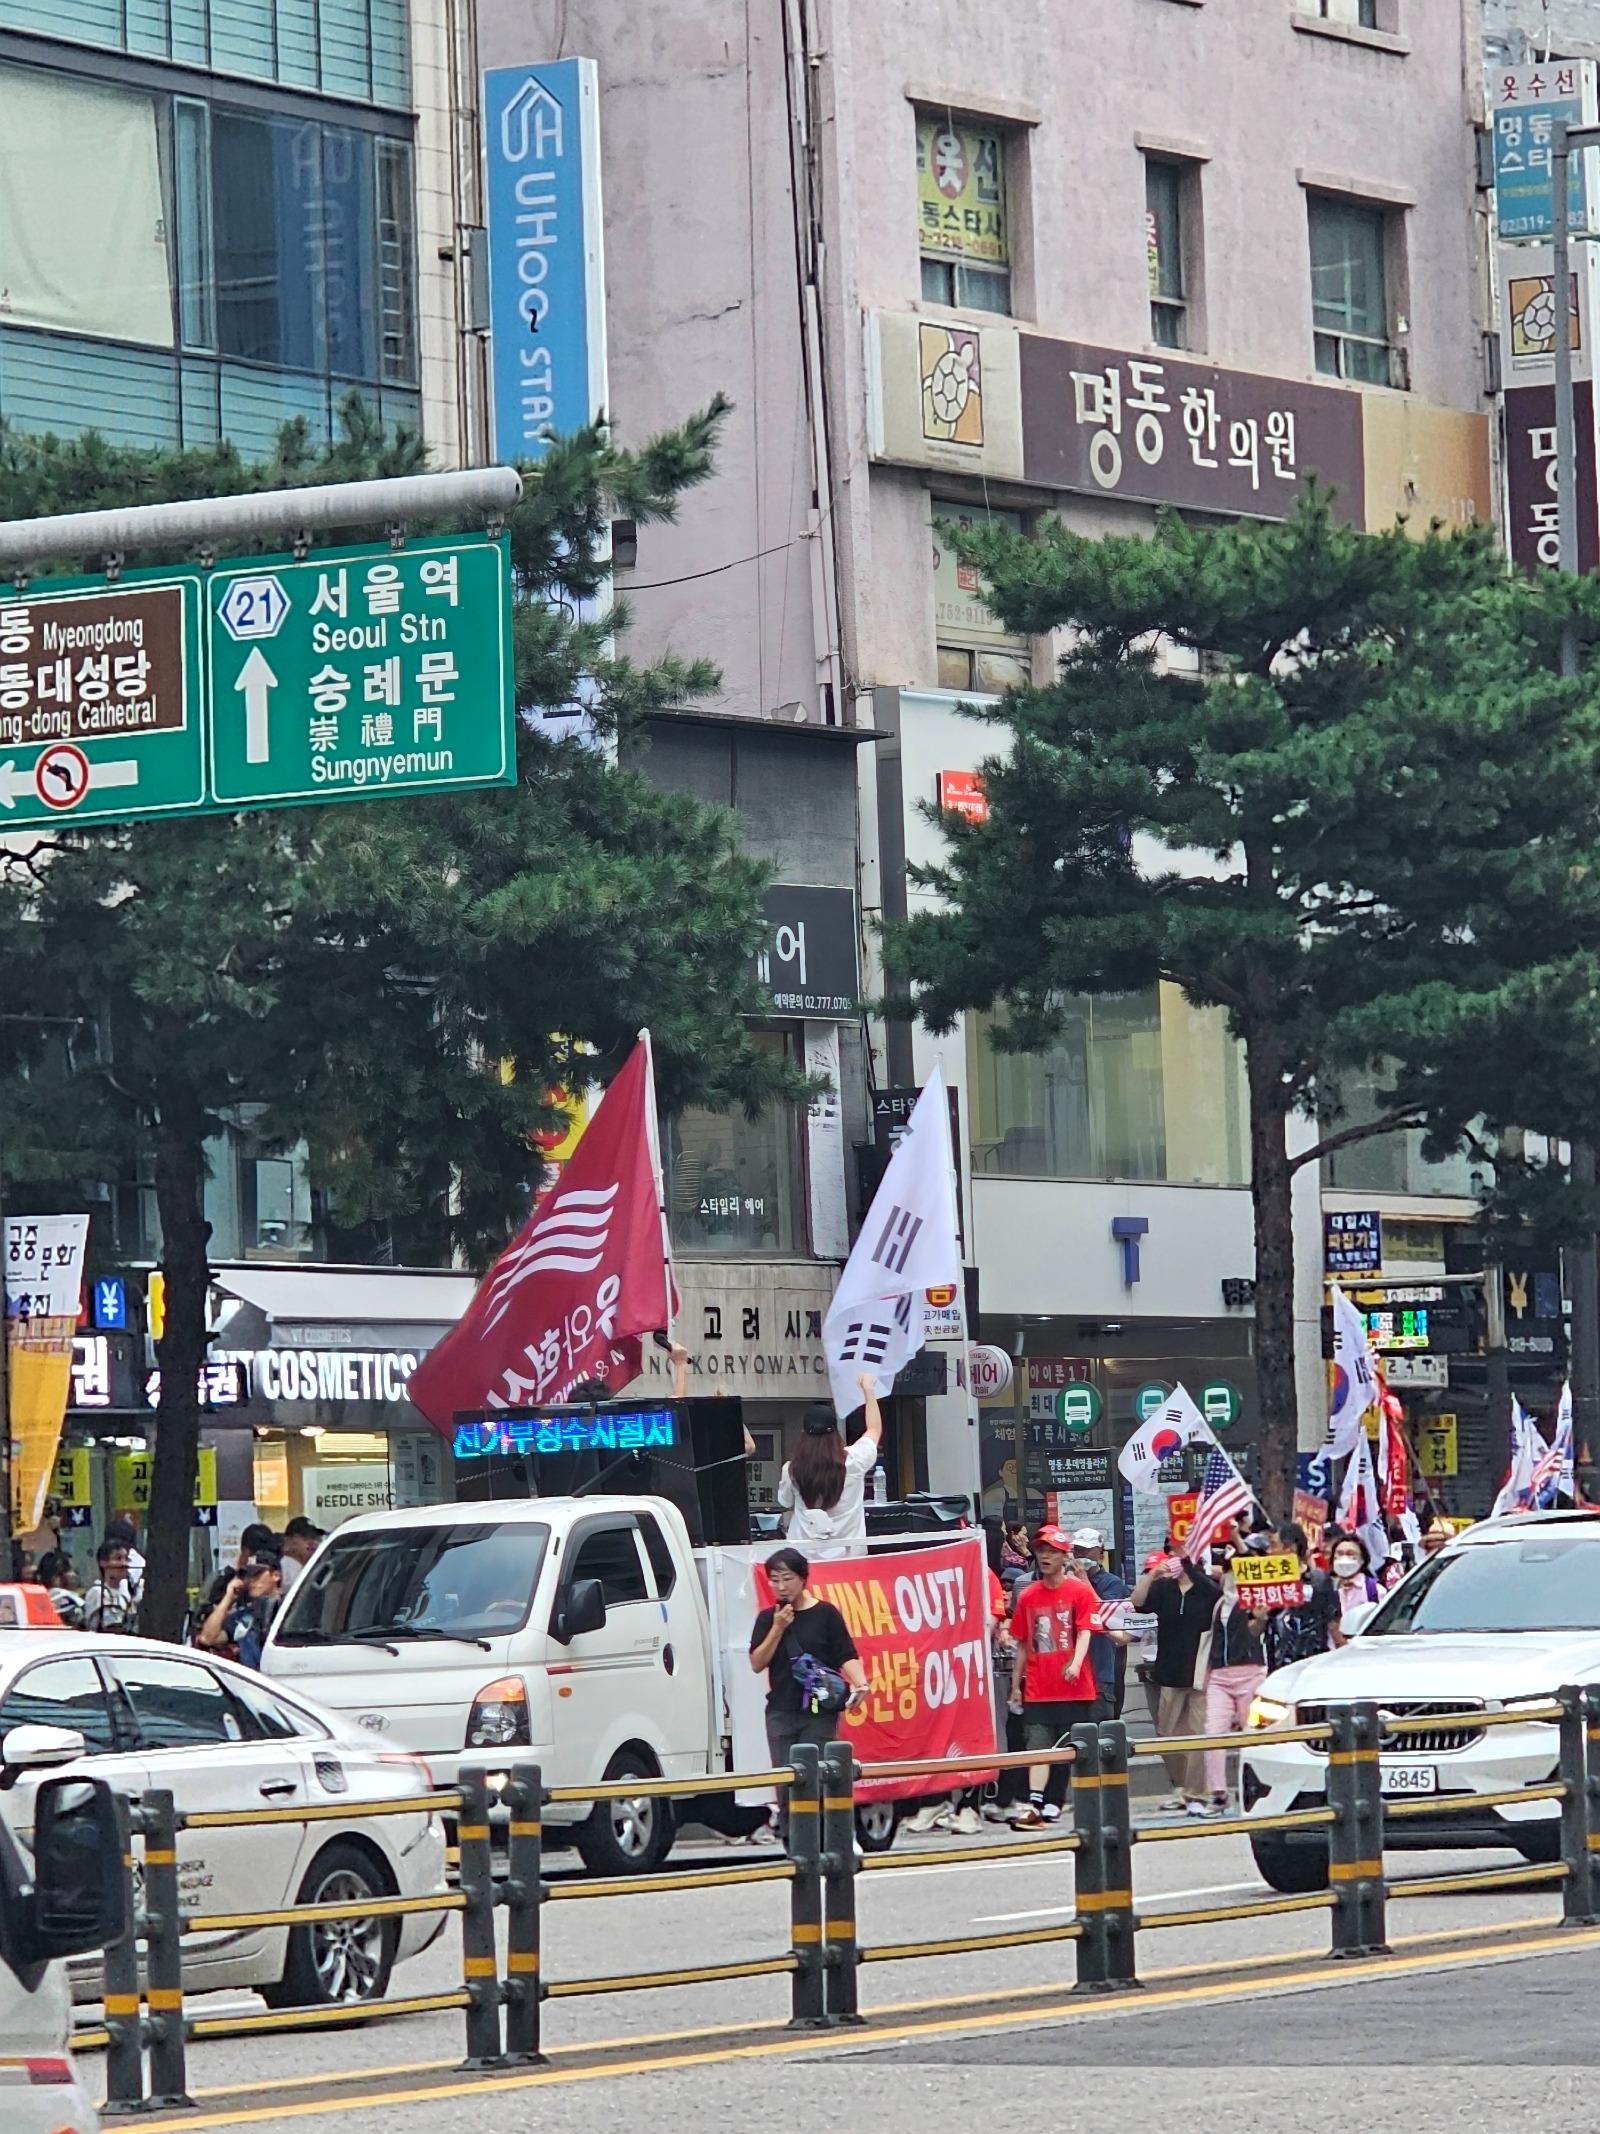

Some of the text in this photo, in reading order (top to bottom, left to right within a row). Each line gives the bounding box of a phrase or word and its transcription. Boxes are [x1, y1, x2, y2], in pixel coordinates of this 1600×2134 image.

[1501, 69, 1575, 102] 옷수선
[308, 556, 458, 618] 서울역
[236, 588, 272, 627] 21
[43, 616, 144, 656] Myeongdong
[312, 613, 447, 653] Seoul Stn
[308, 651, 459, 713] 숭례문
[0, 694, 157, 743] ng-dong Cathedral
[309, 707, 442, 752] 崇禮門
[311, 750, 453, 785] Sungnyemun
[700, 1197, 764, 1215] 스타일리 헤어
[305, 1327, 352, 1344] COSMETICS
[262, 1350, 417, 1402] COSMETICS
[1236, 1560, 1293, 1580] 사법수호
[894, 1566, 966, 1632] OUT!
[924, 1638, 984, 1709] OUT!
[1388, 1770, 1430, 1789] 6845
